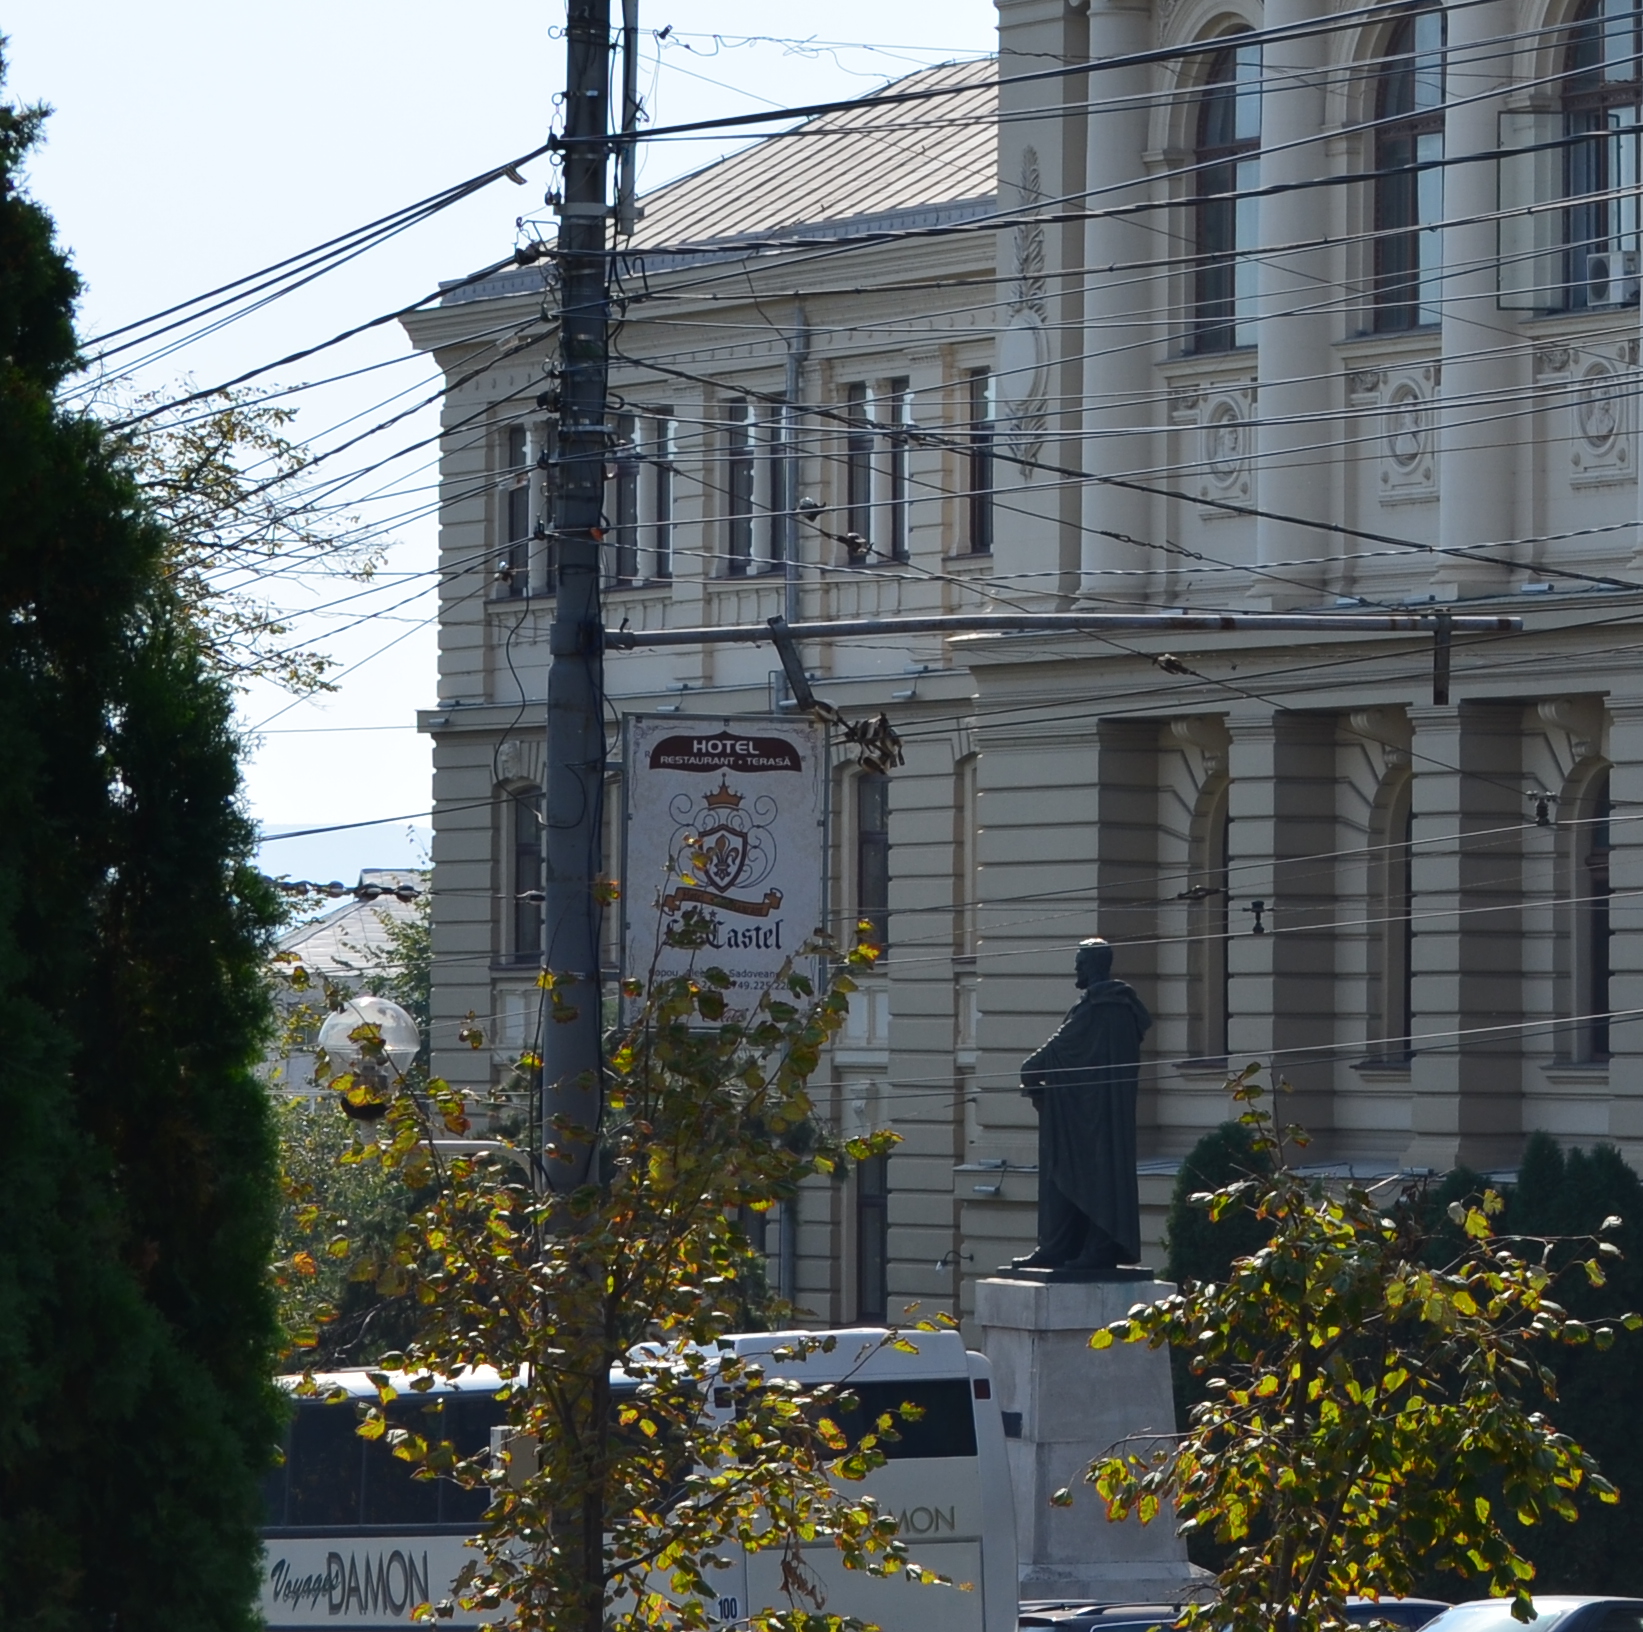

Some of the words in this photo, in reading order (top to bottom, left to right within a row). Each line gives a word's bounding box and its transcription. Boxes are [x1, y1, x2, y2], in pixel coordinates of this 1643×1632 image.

[693, 739, 760, 754] HOTEL
[660, 755, 735, 765] RESTAURANT
[746, 755, 792, 766] TERASĂ
[706, 919, 784, 950] Castel
[270, 1558, 341, 1612] Voyages
[326, 1549, 430, 1617] DAMON
[718, 1597, 738, 1619] 100
